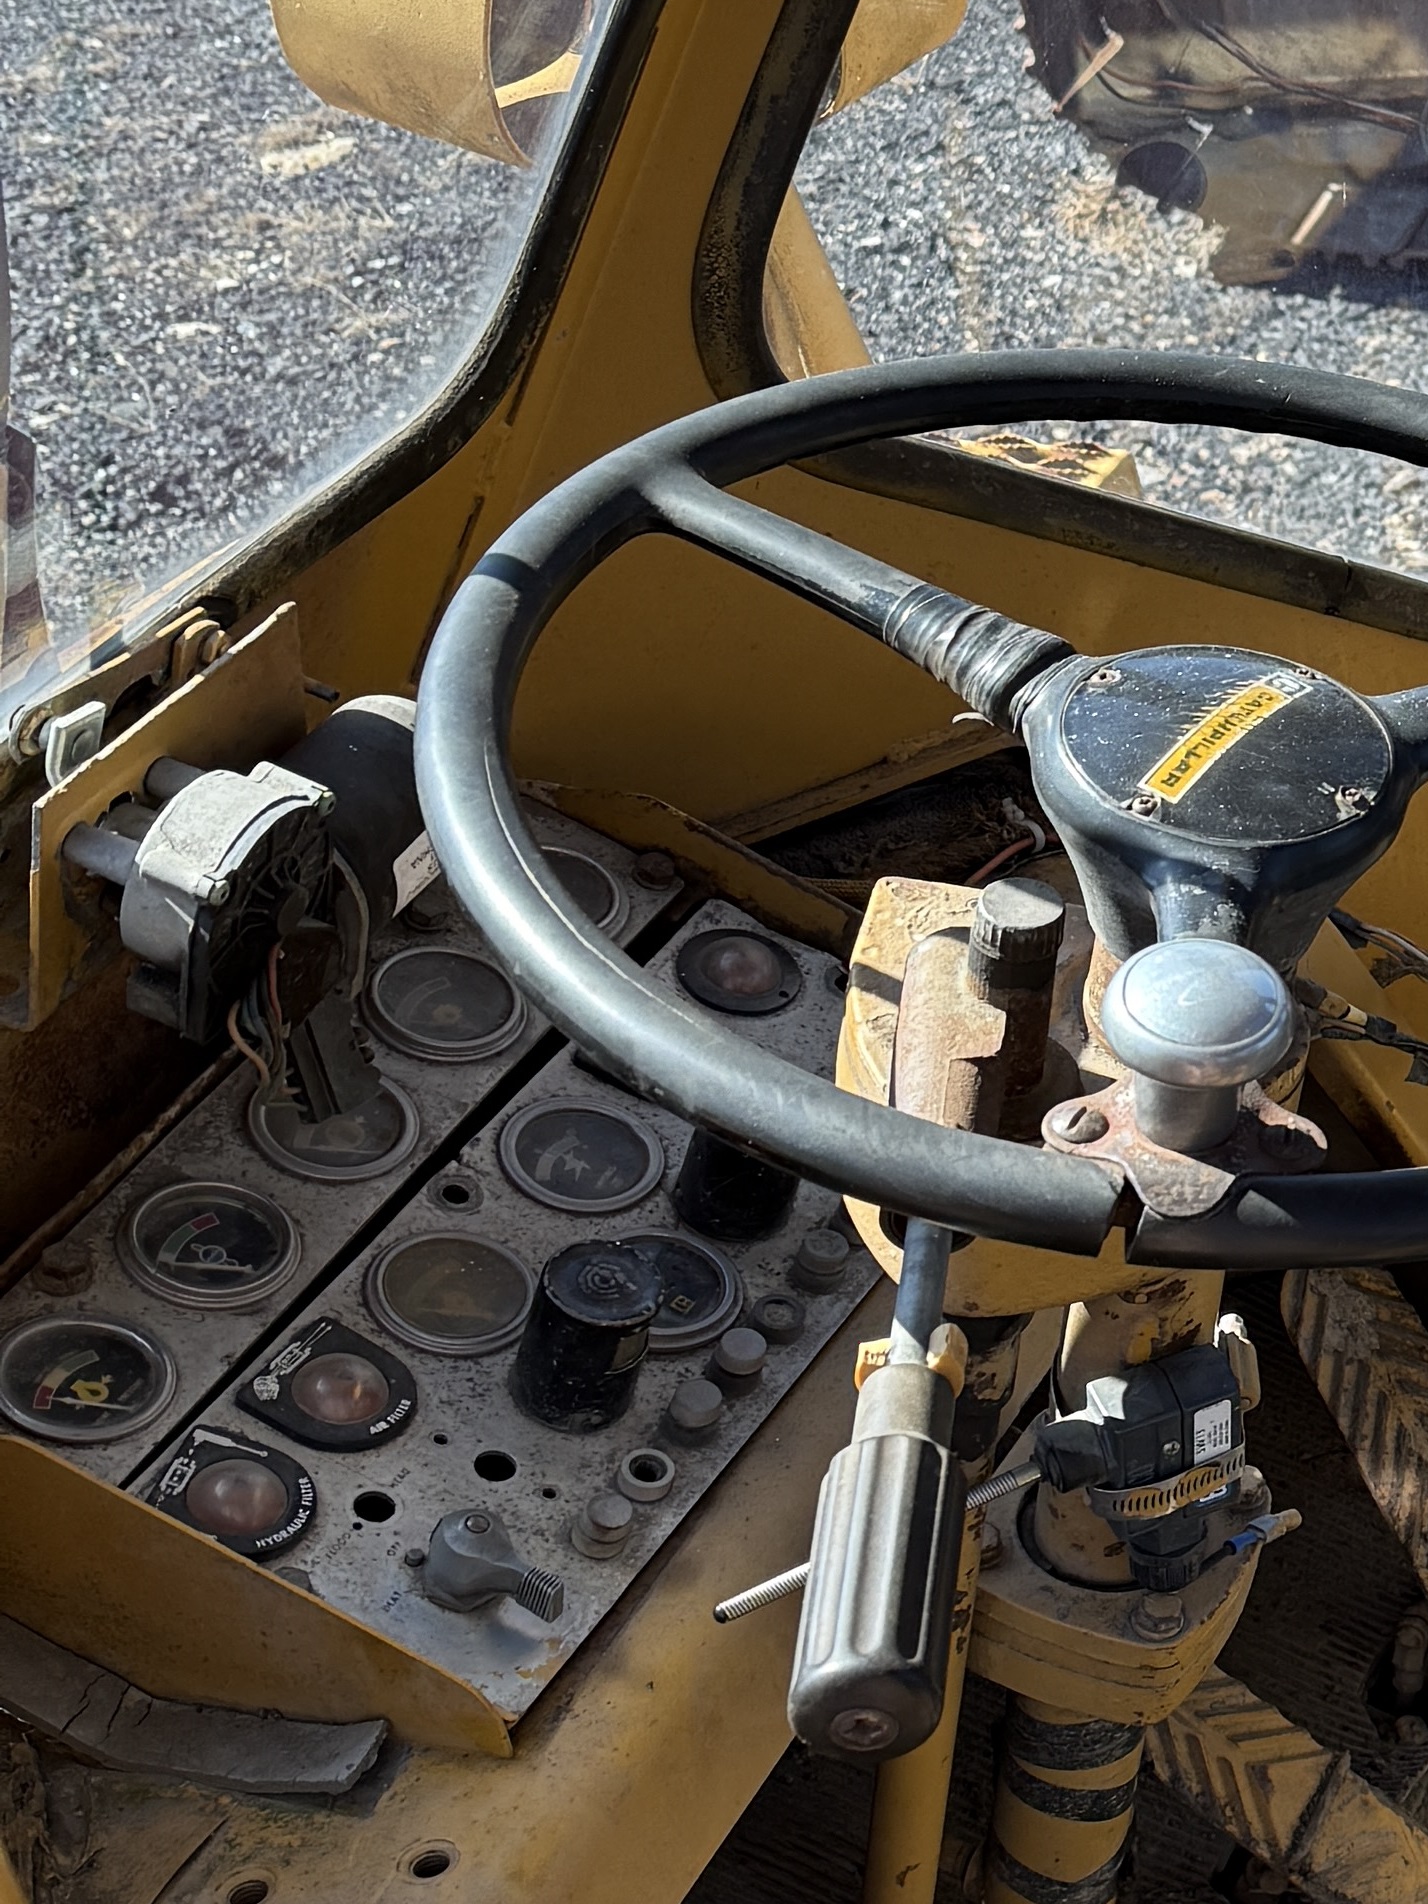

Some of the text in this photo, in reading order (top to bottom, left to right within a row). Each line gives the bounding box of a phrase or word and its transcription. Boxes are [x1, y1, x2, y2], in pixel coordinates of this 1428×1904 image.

[1160, 691, 1274, 788] CATERPILLAR
[369, 1399, 411, 1435] AIR FILTER
[255, 1476, 314, 1549] HYDRAULIC FILTER
